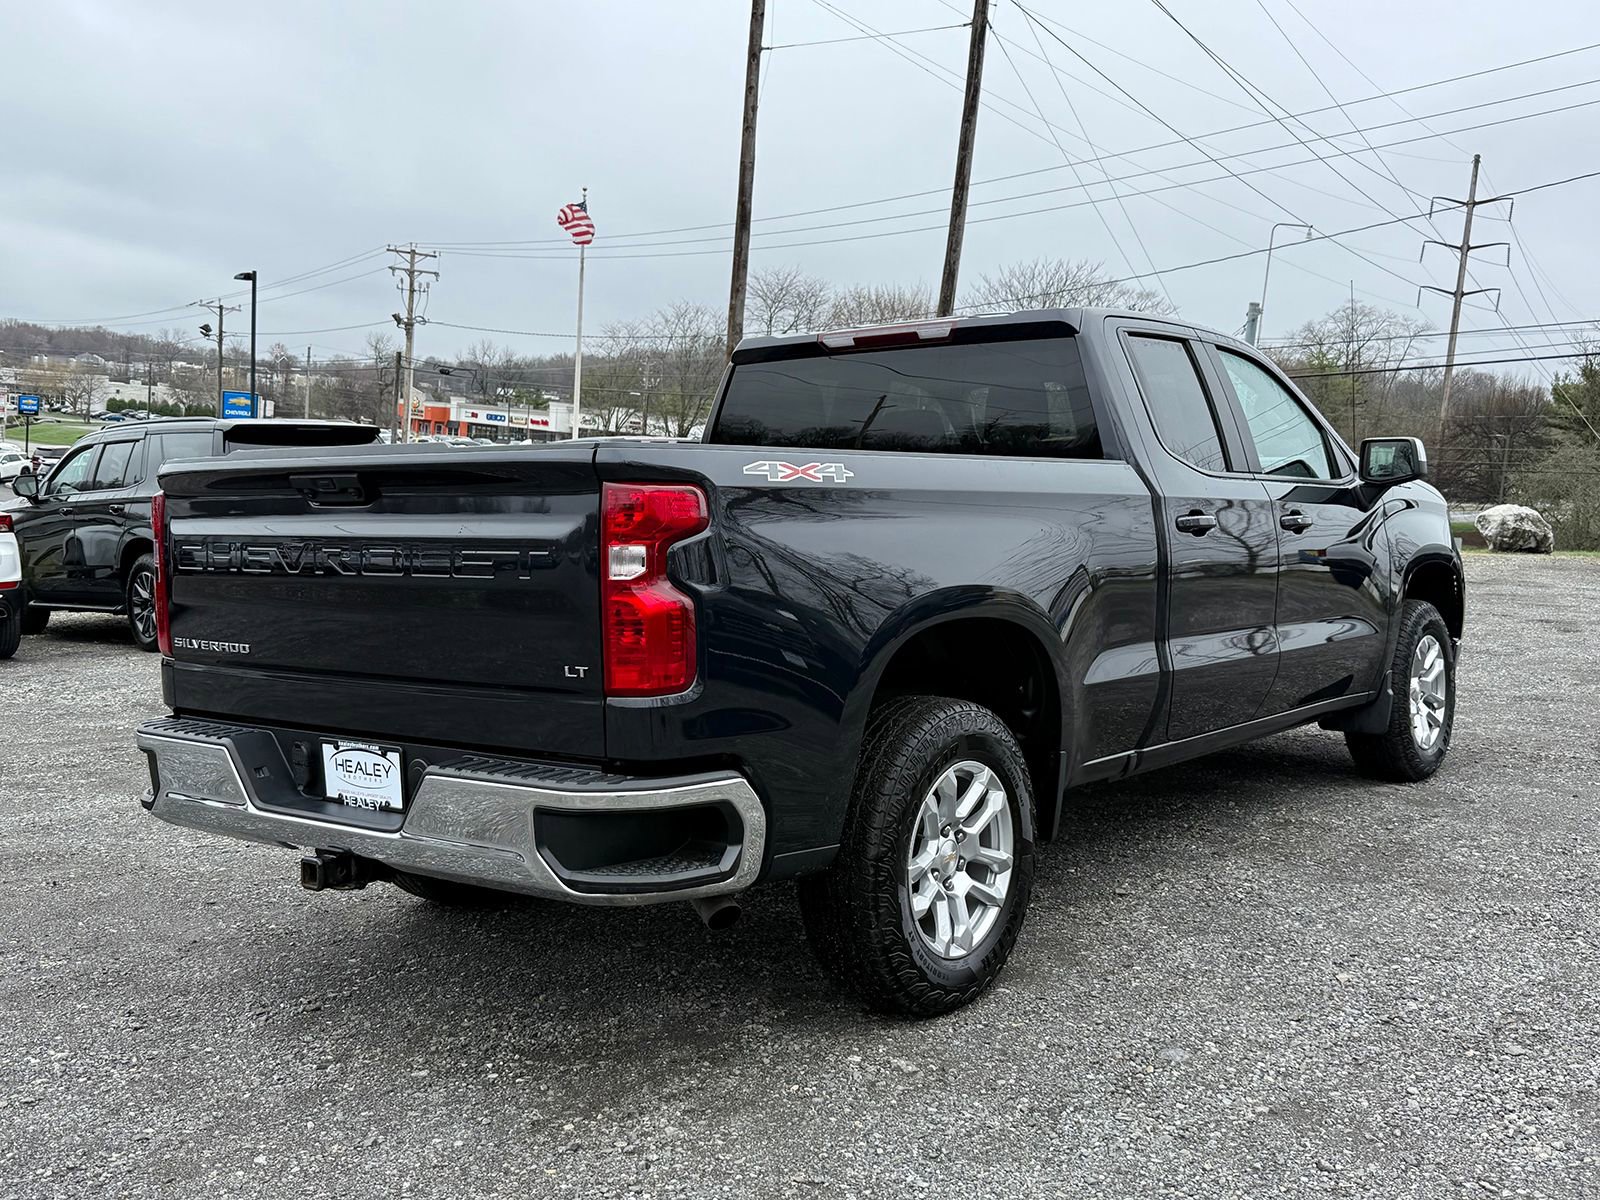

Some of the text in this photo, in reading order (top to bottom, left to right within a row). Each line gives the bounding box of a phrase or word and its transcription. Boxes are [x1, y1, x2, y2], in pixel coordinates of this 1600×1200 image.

[177, 541, 555, 580] CHEVROLET
[174, 637, 251, 654] SILVERADO
[564, 665, 589, 678] LT
[335, 757, 392, 779] HEALEY
[343, 795, 382, 811] HEALEY
